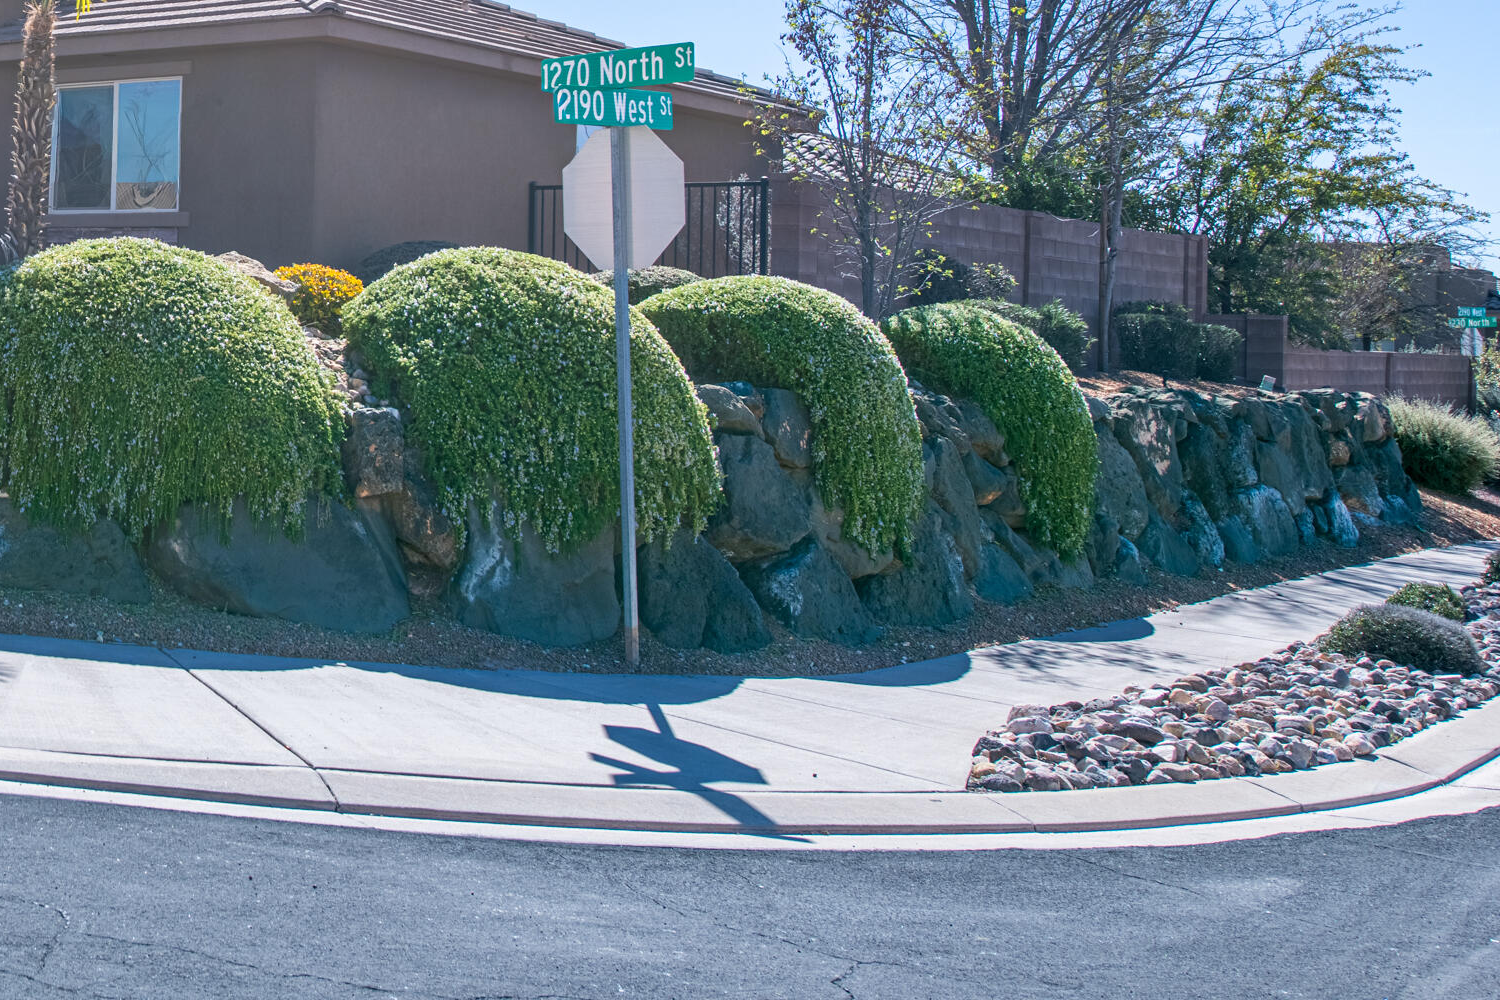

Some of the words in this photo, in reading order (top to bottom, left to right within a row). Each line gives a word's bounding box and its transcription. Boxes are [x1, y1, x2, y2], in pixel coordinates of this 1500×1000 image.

[542, 58, 590, 90] 1270
[600, 51, 664, 86] North
[674, 46, 693, 68] St
[557, 88, 605, 121] 2190
[613, 92, 654, 124] West
[659, 95, 672, 116] St
[1468, 318, 1490, 327] North
